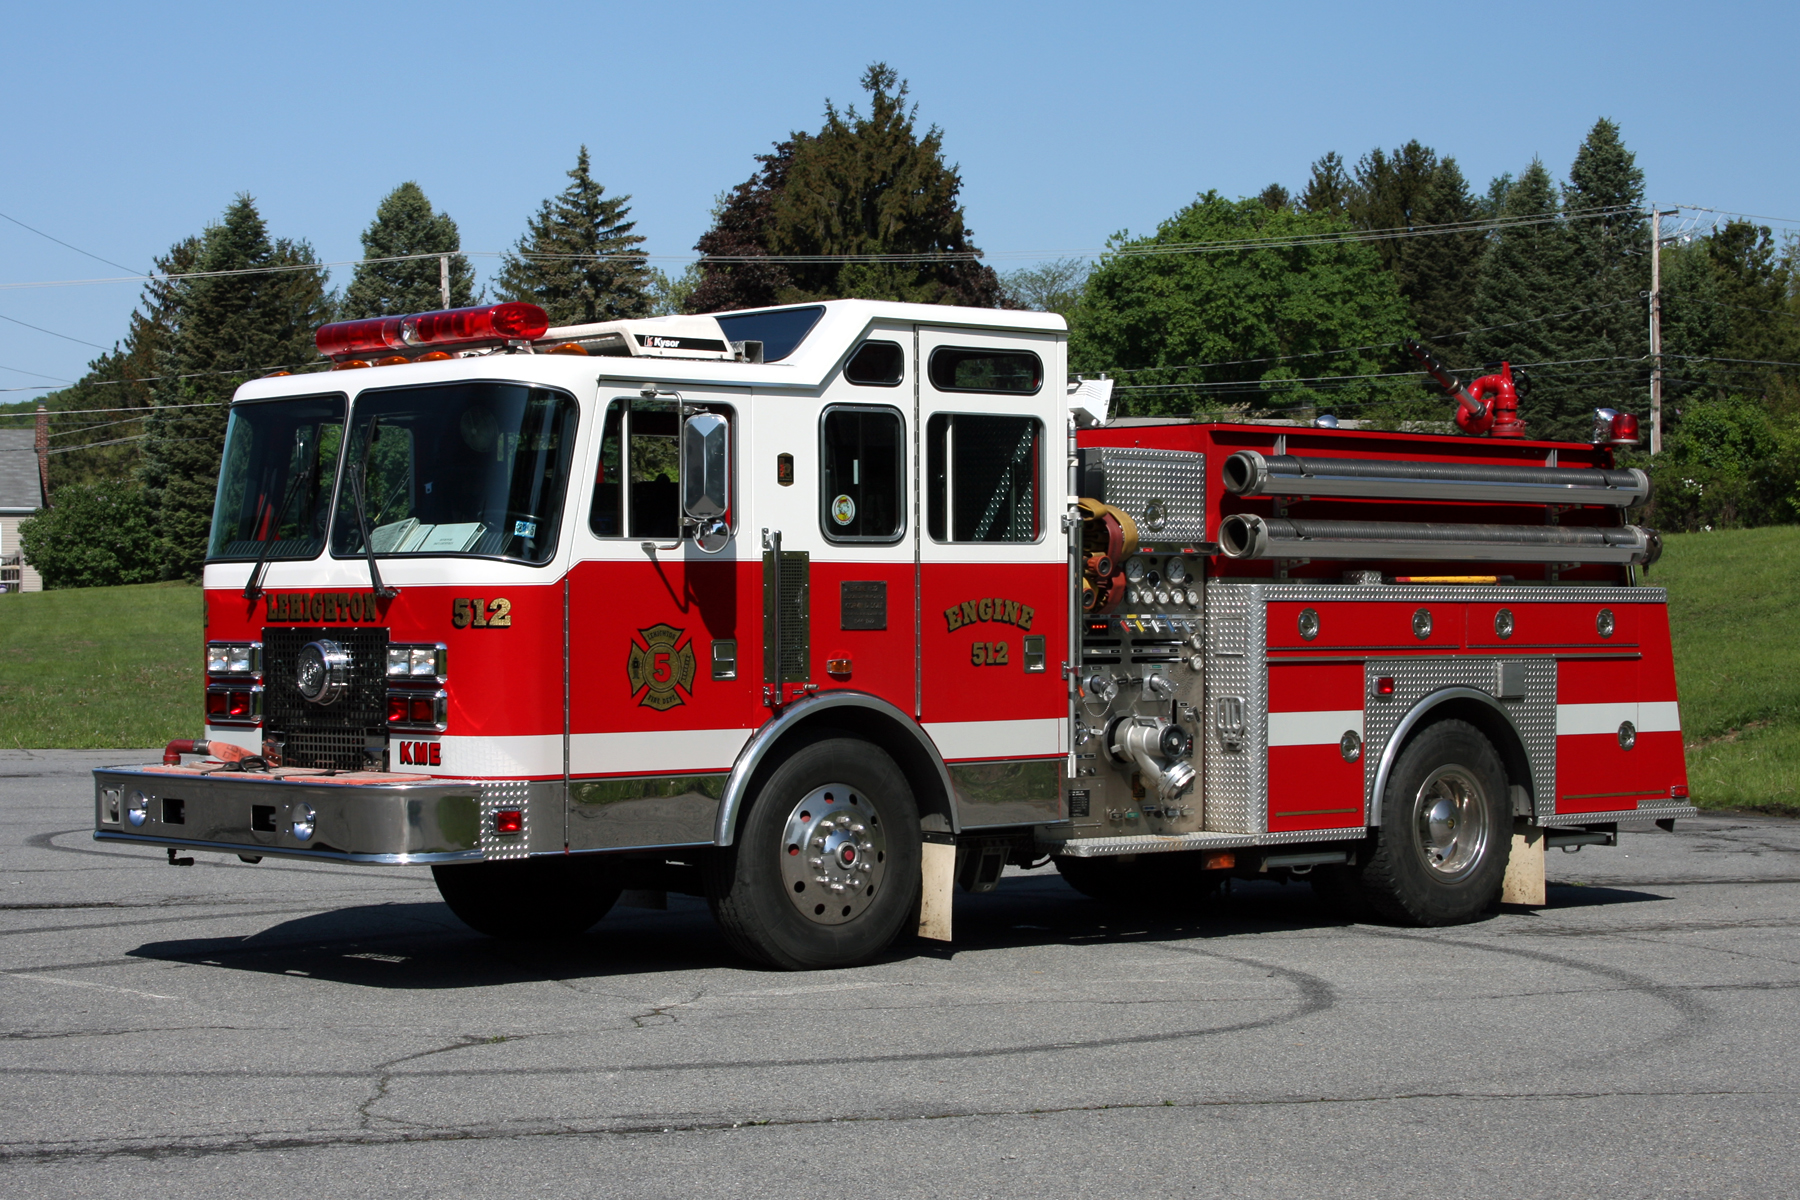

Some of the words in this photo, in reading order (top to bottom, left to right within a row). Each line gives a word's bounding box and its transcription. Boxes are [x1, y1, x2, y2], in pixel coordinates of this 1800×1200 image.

[654, 337, 680, 348] Kysor
[266, 592, 377, 622] LEHIGHTON
[452, 597, 511, 629] 512
[944, 598, 1035, 633] ENGINE
[653, 652, 672, 683] 5
[971, 641, 1009, 667] 512
[400, 741, 441, 766] KME
